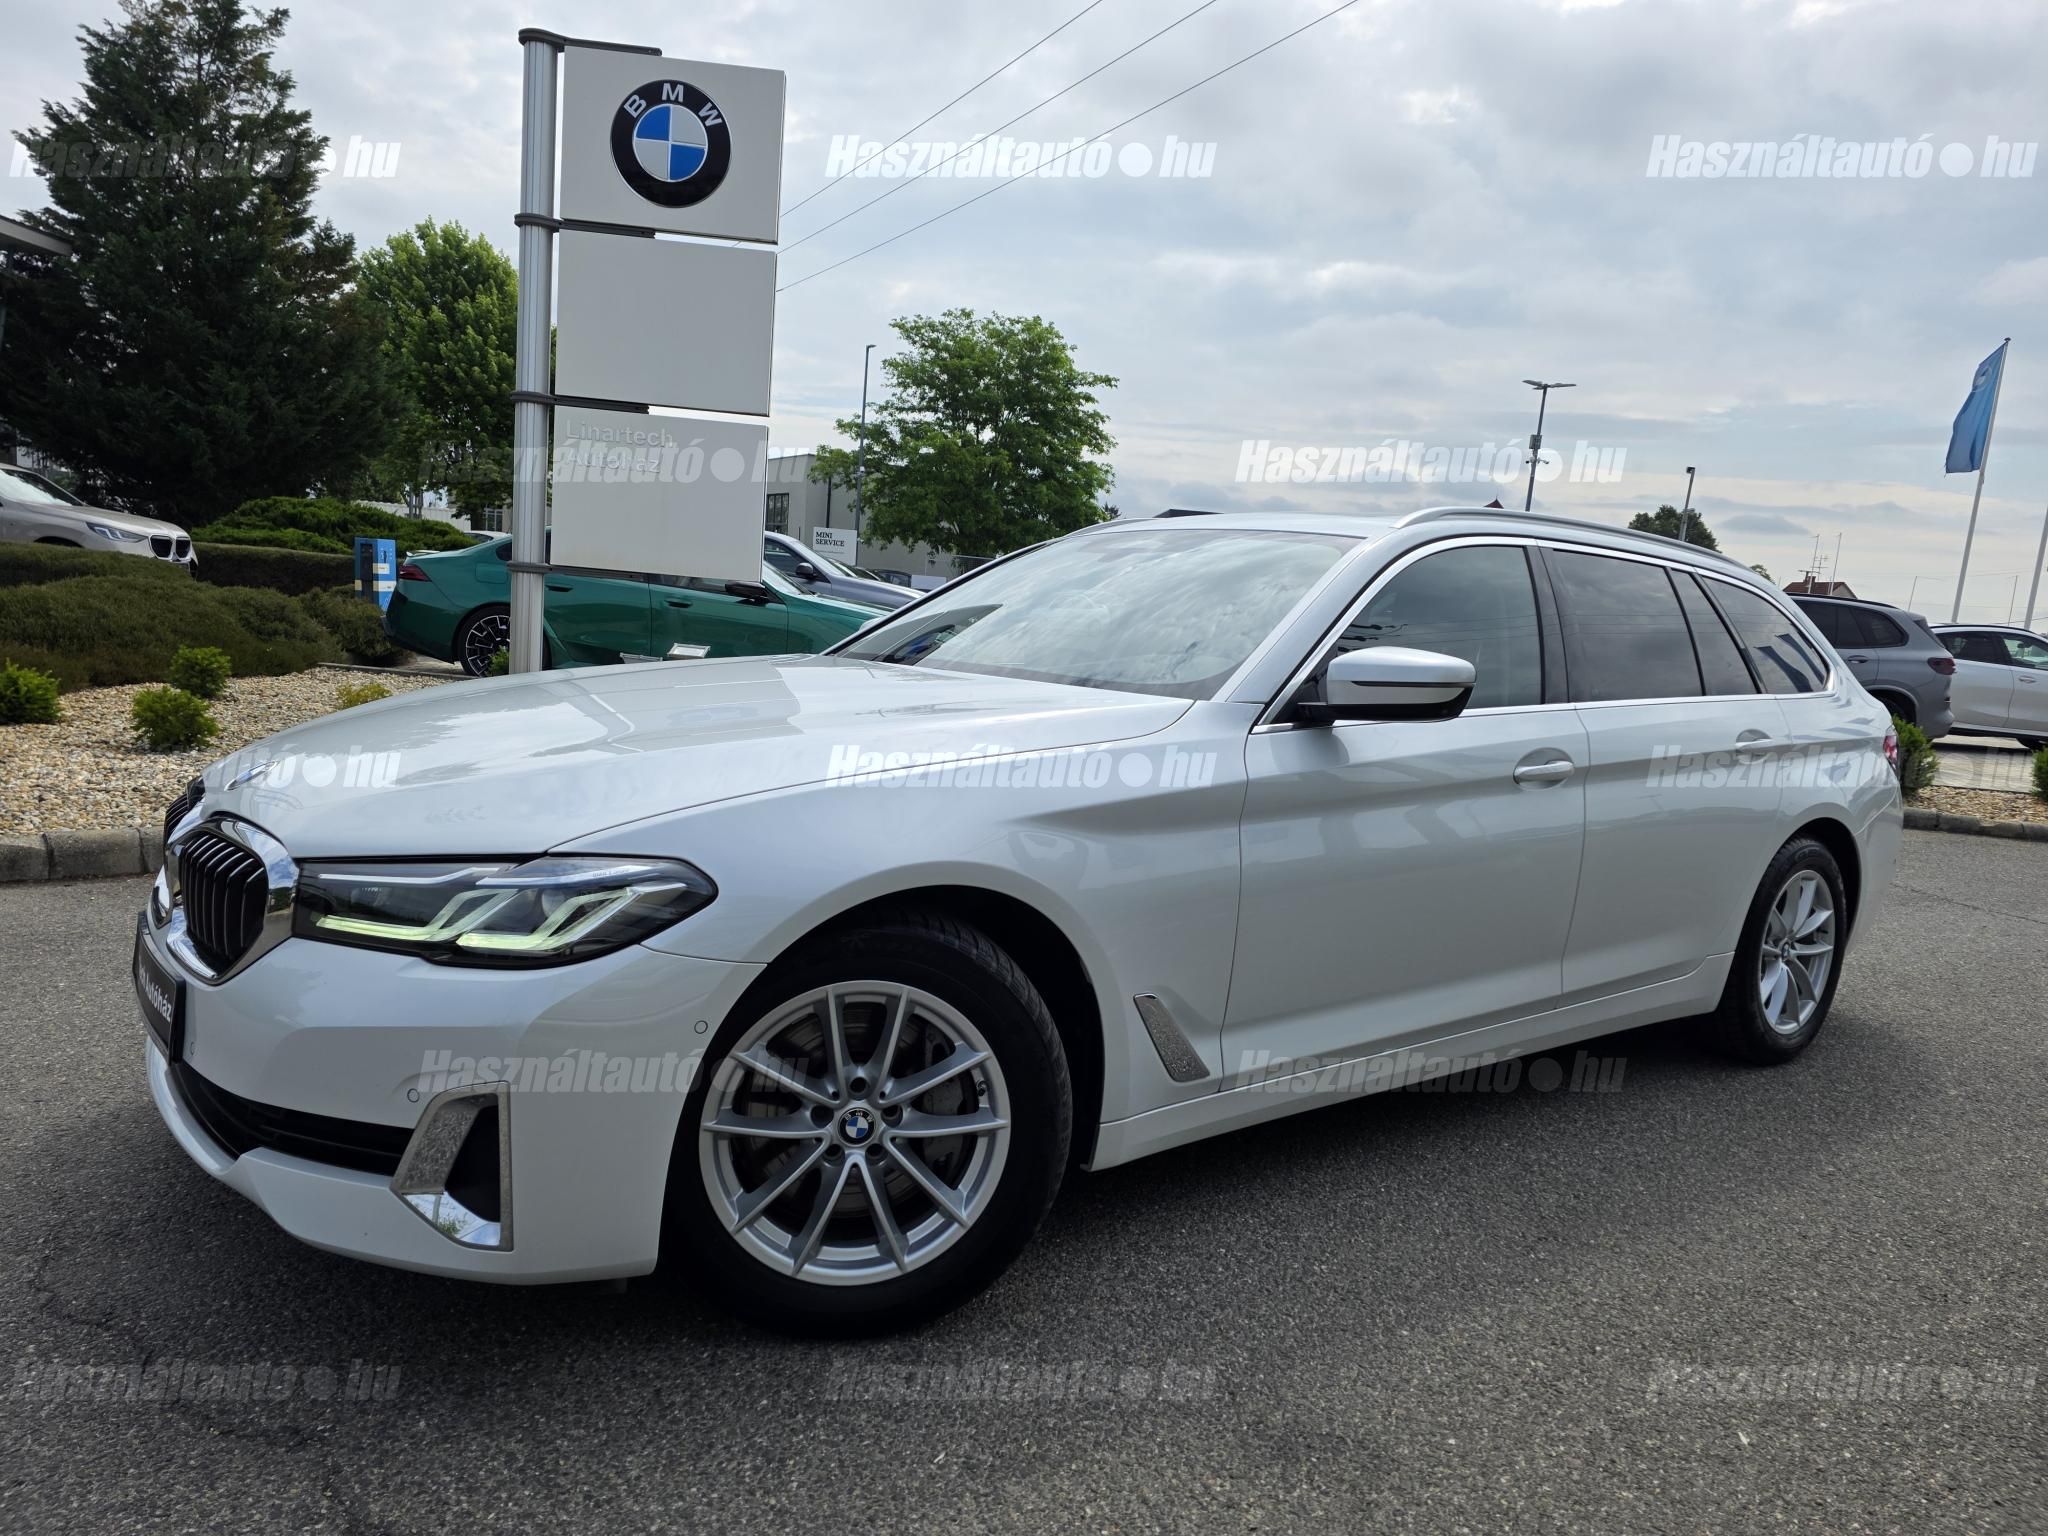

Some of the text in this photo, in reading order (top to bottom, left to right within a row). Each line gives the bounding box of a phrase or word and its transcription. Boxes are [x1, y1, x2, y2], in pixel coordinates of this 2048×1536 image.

[623, 83, 722, 127] BMW
[816, 531, 833, 539] MINI
[815, 538, 845, 547] SERVICE
